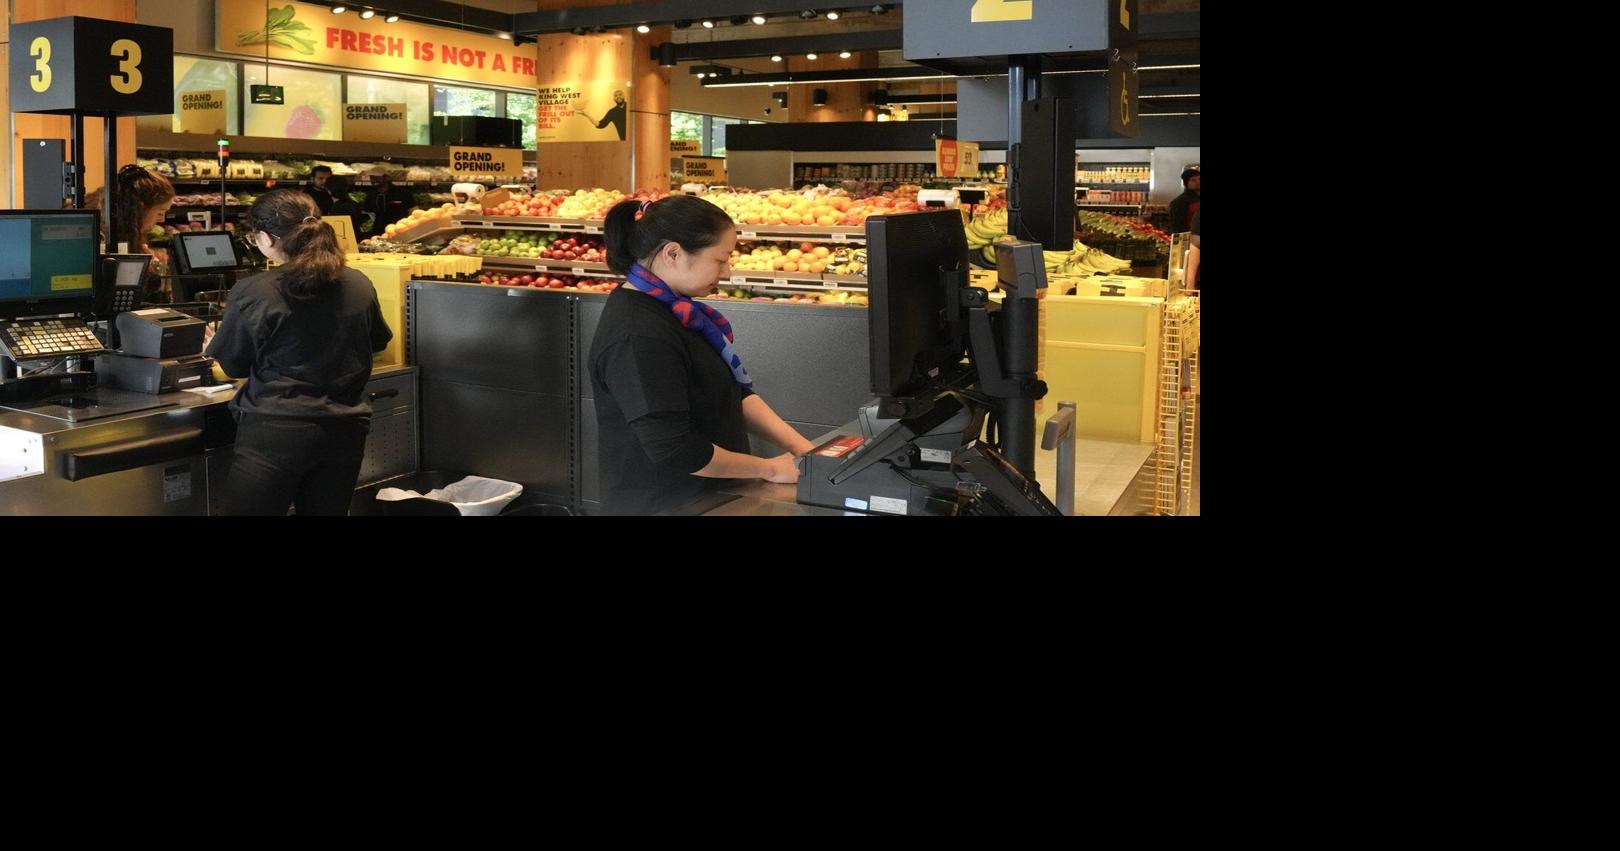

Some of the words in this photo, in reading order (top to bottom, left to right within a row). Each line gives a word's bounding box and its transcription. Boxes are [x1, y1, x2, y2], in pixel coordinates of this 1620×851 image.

[326, 27, 404, 58] FRESH
[413, 40, 434, 62] IS
[442, 44, 486, 69] NOT
[492, 53, 506, 72] A
[30, 36, 52, 93] 3
[110, 38, 143, 95] 3
[182, 93, 212, 102] GRAND
[182, 101, 223, 110] OPENING!
[346, 105, 387, 113] GRAND
[346, 112, 403, 120] OPENING!
[454, 151, 492, 162] GRAND
[454, 161, 505, 172] OPENING!
[686, 169, 715, 177] OPENING!
